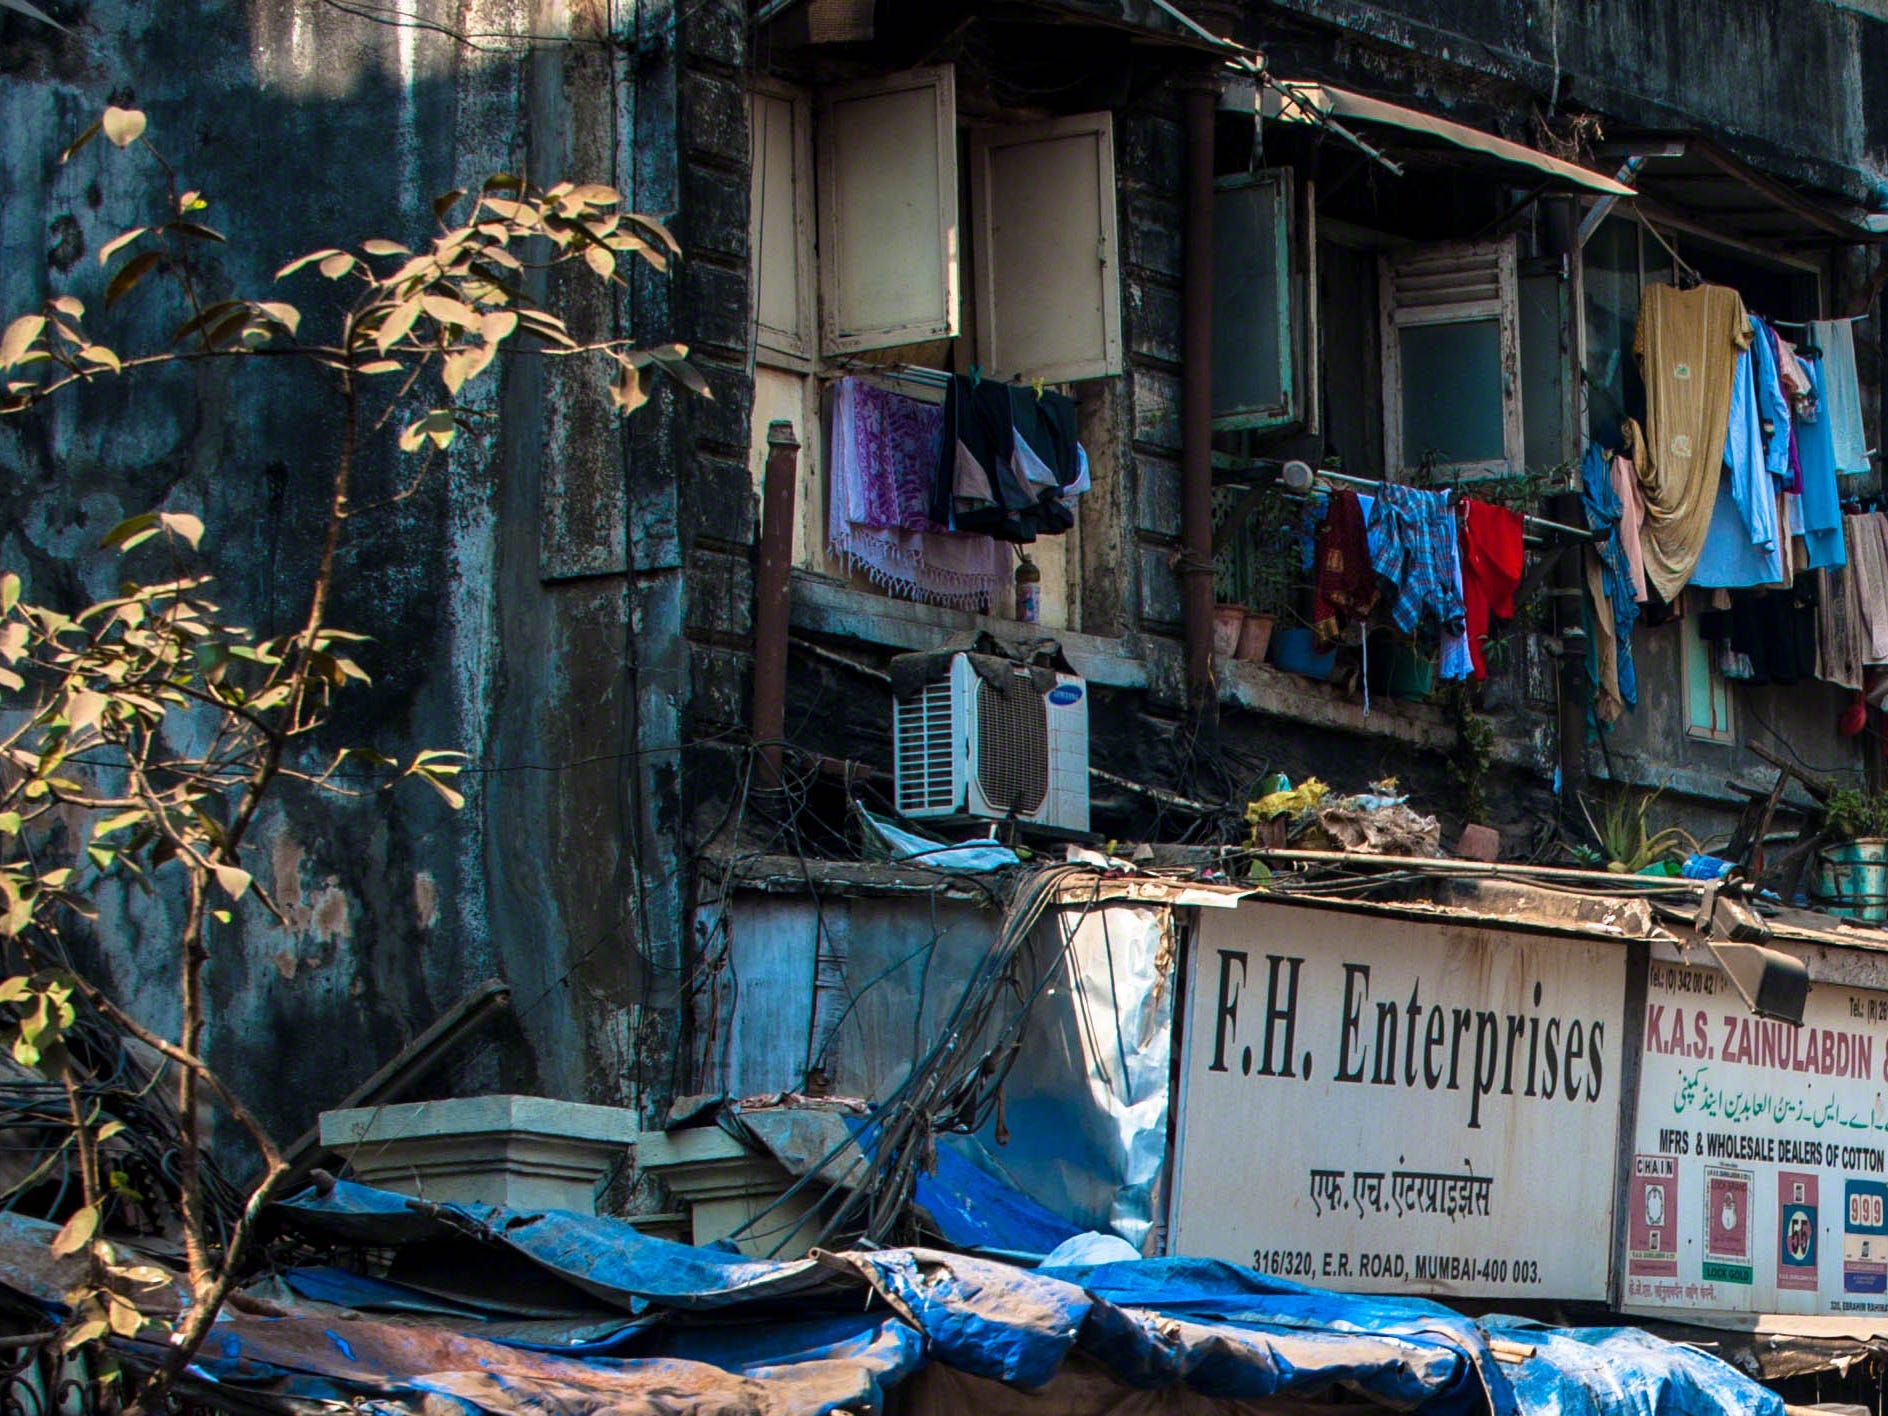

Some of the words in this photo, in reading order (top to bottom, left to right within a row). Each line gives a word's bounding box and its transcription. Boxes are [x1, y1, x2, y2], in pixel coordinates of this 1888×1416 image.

[1208, 949, 1313, 1081] F.H.
[1334, 962, 1605, 1129] Enterprises
[1646, 1004, 1714, 1060] K.A.S.
[1721, 1015, 1873, 1081] ZAINULABDIN
[1636, 1159, 1674, 1175] CHAIN
[1659, 1128, 1689, 1155] MFRS
[1695, 1132, 1704, 1156] &
[1707, 1133, 1775, 1163] WHOLESALE
[1778, 1138, 1823, 1167] DEALERS
[1826, 1143, 1840, 1169] OF
[1841, 1145, 1886, 1174] COTTON
[1852, 1197, 1882, 1224] 999
[1791, 1218, 1808, 1255] 55
[1252, 1249, 1317, 1280] 316/320,
[1322, 1252, 1353, 1277] E.R.
[1359, 1254, 1409, 1282] ROAD,
[1415, 1255, 1508, 1282] MUMBAI-400
[1512, 1259, 1542, 1284] 003.
[1707, 1268, 1728, 1279] LOCK
[1729, 1269, 1750, 1281] GOLD
